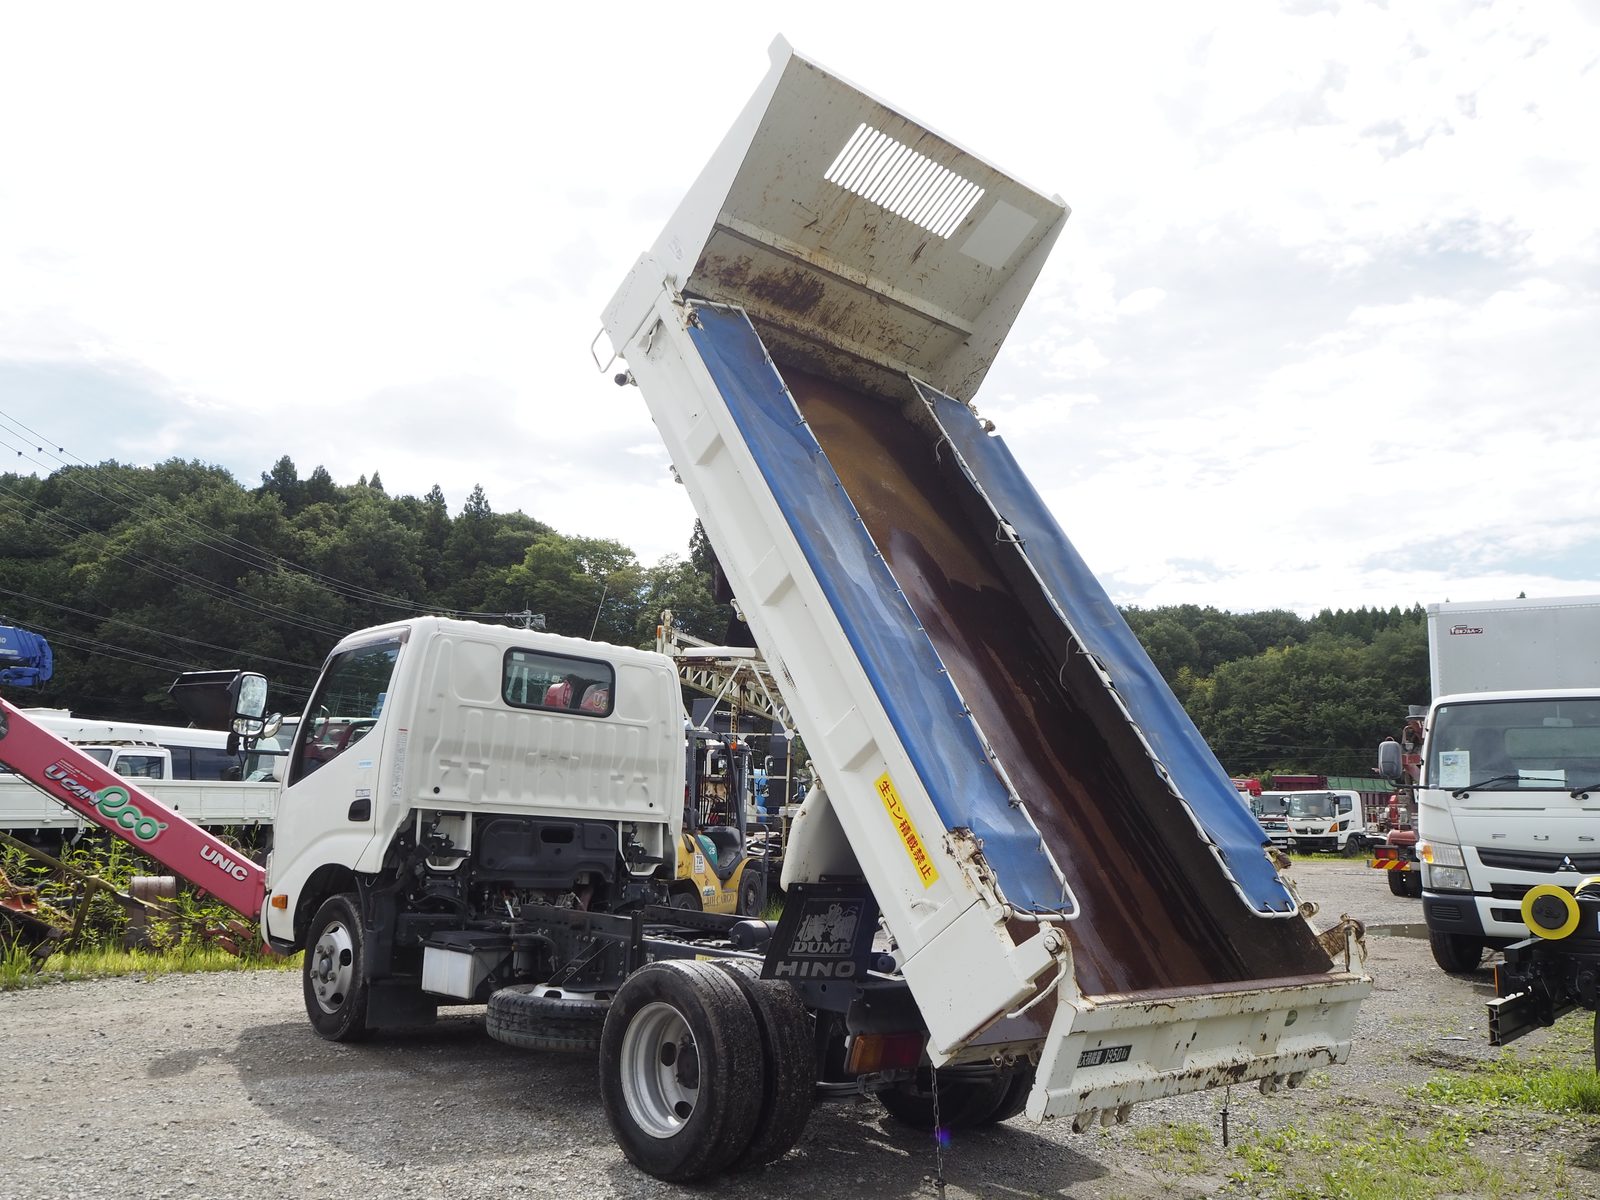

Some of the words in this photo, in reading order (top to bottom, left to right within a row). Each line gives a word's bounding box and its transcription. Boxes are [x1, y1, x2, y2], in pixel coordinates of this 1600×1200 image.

[878, 780, 931, 881] 生コン積載禁止
[200, 844, 249, 881] UNIC
[791, 941, 852, 954] DUMP
[774, 960, 856, 978] HINO
